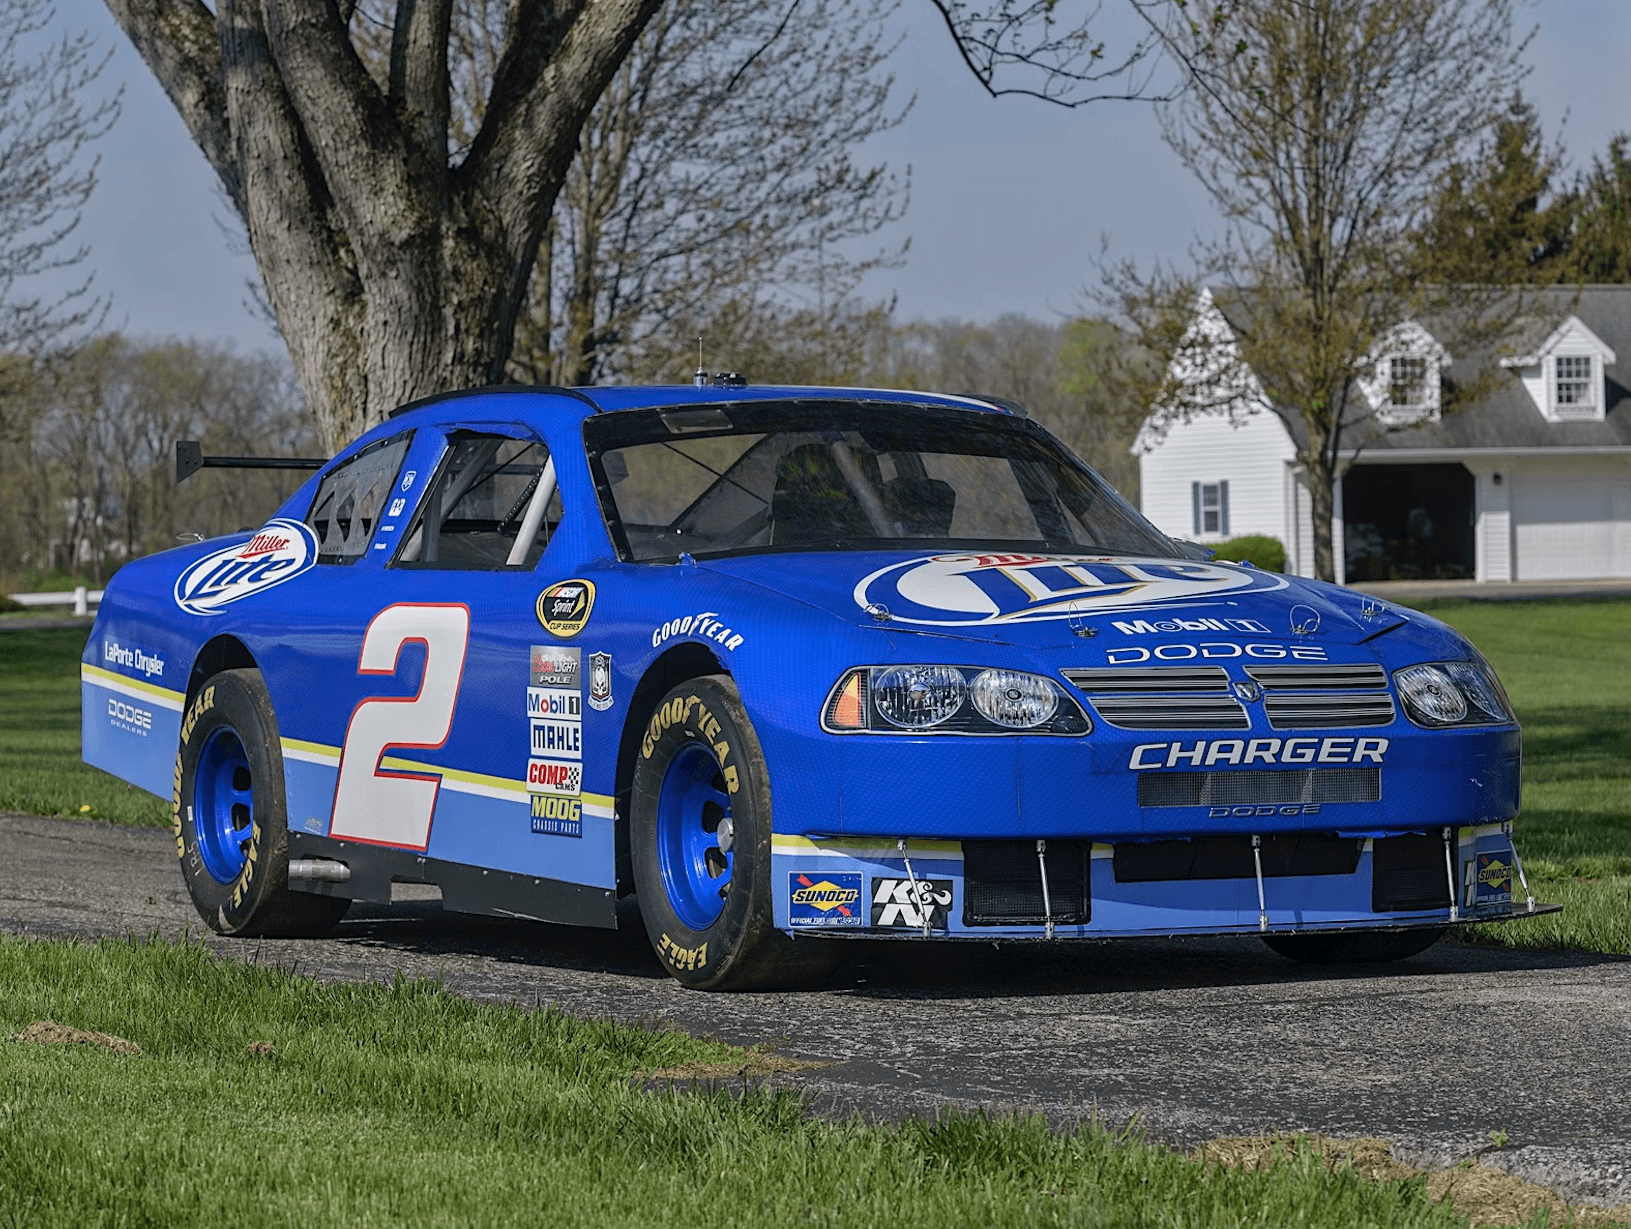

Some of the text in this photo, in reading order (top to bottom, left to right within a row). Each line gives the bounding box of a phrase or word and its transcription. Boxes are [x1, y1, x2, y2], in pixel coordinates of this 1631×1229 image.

[243, 535, 291, 554] Miller
[183, 554, 296, 602] Lite
[551, 599, 576, 617] Sprint
[550, 622, 581, 631] CUP SERIES
[652, 612, 744, 652] GOODYEAR
[1110, 617, 1230, 635] Mobil
[104, 640, 165, 677] LaPorte Chrysler
[1106, 642, 1329, 664] DODGE
[554, 660, 578, 674] LIGHT
[539, 675, 573, 685] POLE
[108, 698, 152, 730] DODGE
[528, 693, 566, 715] Mobil
[569, 696, 580, 715] 1
[110, 719, 148, 738] DEALERS
[328, 602, 470, 853] 2
[533, 724, 580, 752] MAHLE
[642, 694, 740, 797] GOODYEAR
[1128, 737, 1390, 770] CHARGER
[529, 763, 569, 786] COMP
[555, 782, 576, 792] CAMS
[531, 796, 582, 822] MOOG
[1208, 803, 1321, 818] DODGE
[532, 818, 580, 834] CHASSIS PARTS
[1480, 867, 1512, 880] SUNOCO
[794, 890, 856, 903] SUNOCO
[657, 932, 709, 971] EAGLE
